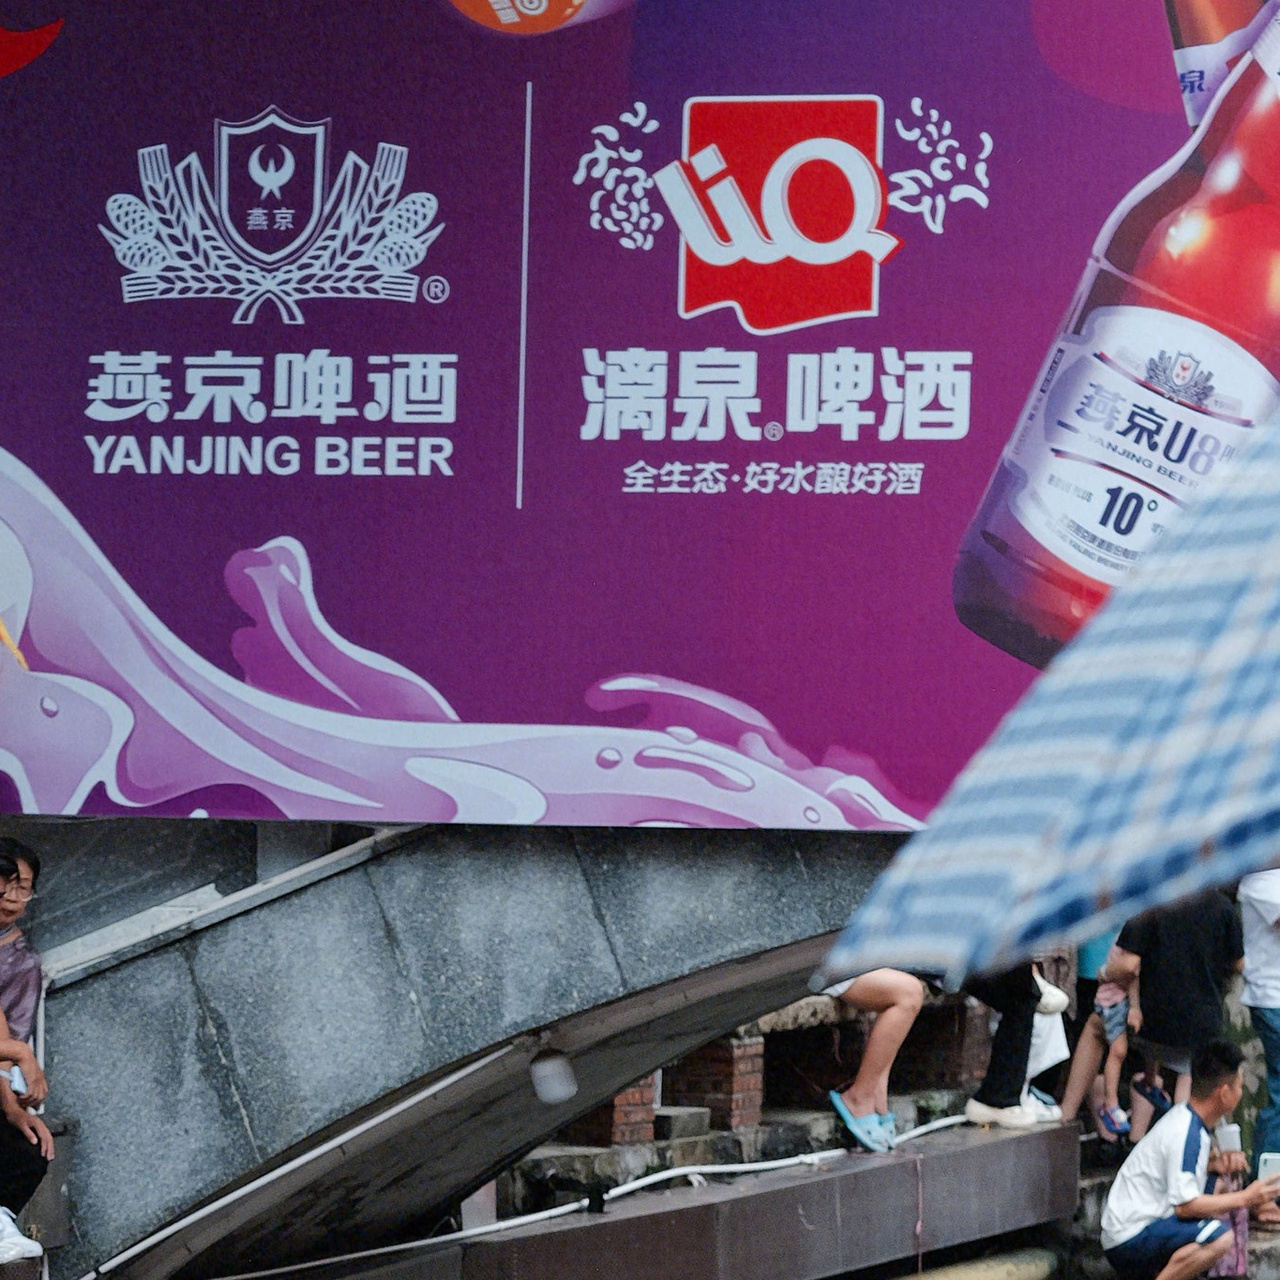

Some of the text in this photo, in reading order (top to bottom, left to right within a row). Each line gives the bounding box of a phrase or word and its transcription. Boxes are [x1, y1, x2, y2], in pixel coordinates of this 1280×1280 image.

[246, 207, 296, 231] 燕京
[83, 348, 459, 425] 燕京啤酒
[84, 435, 455, 476] YANJING BEER
